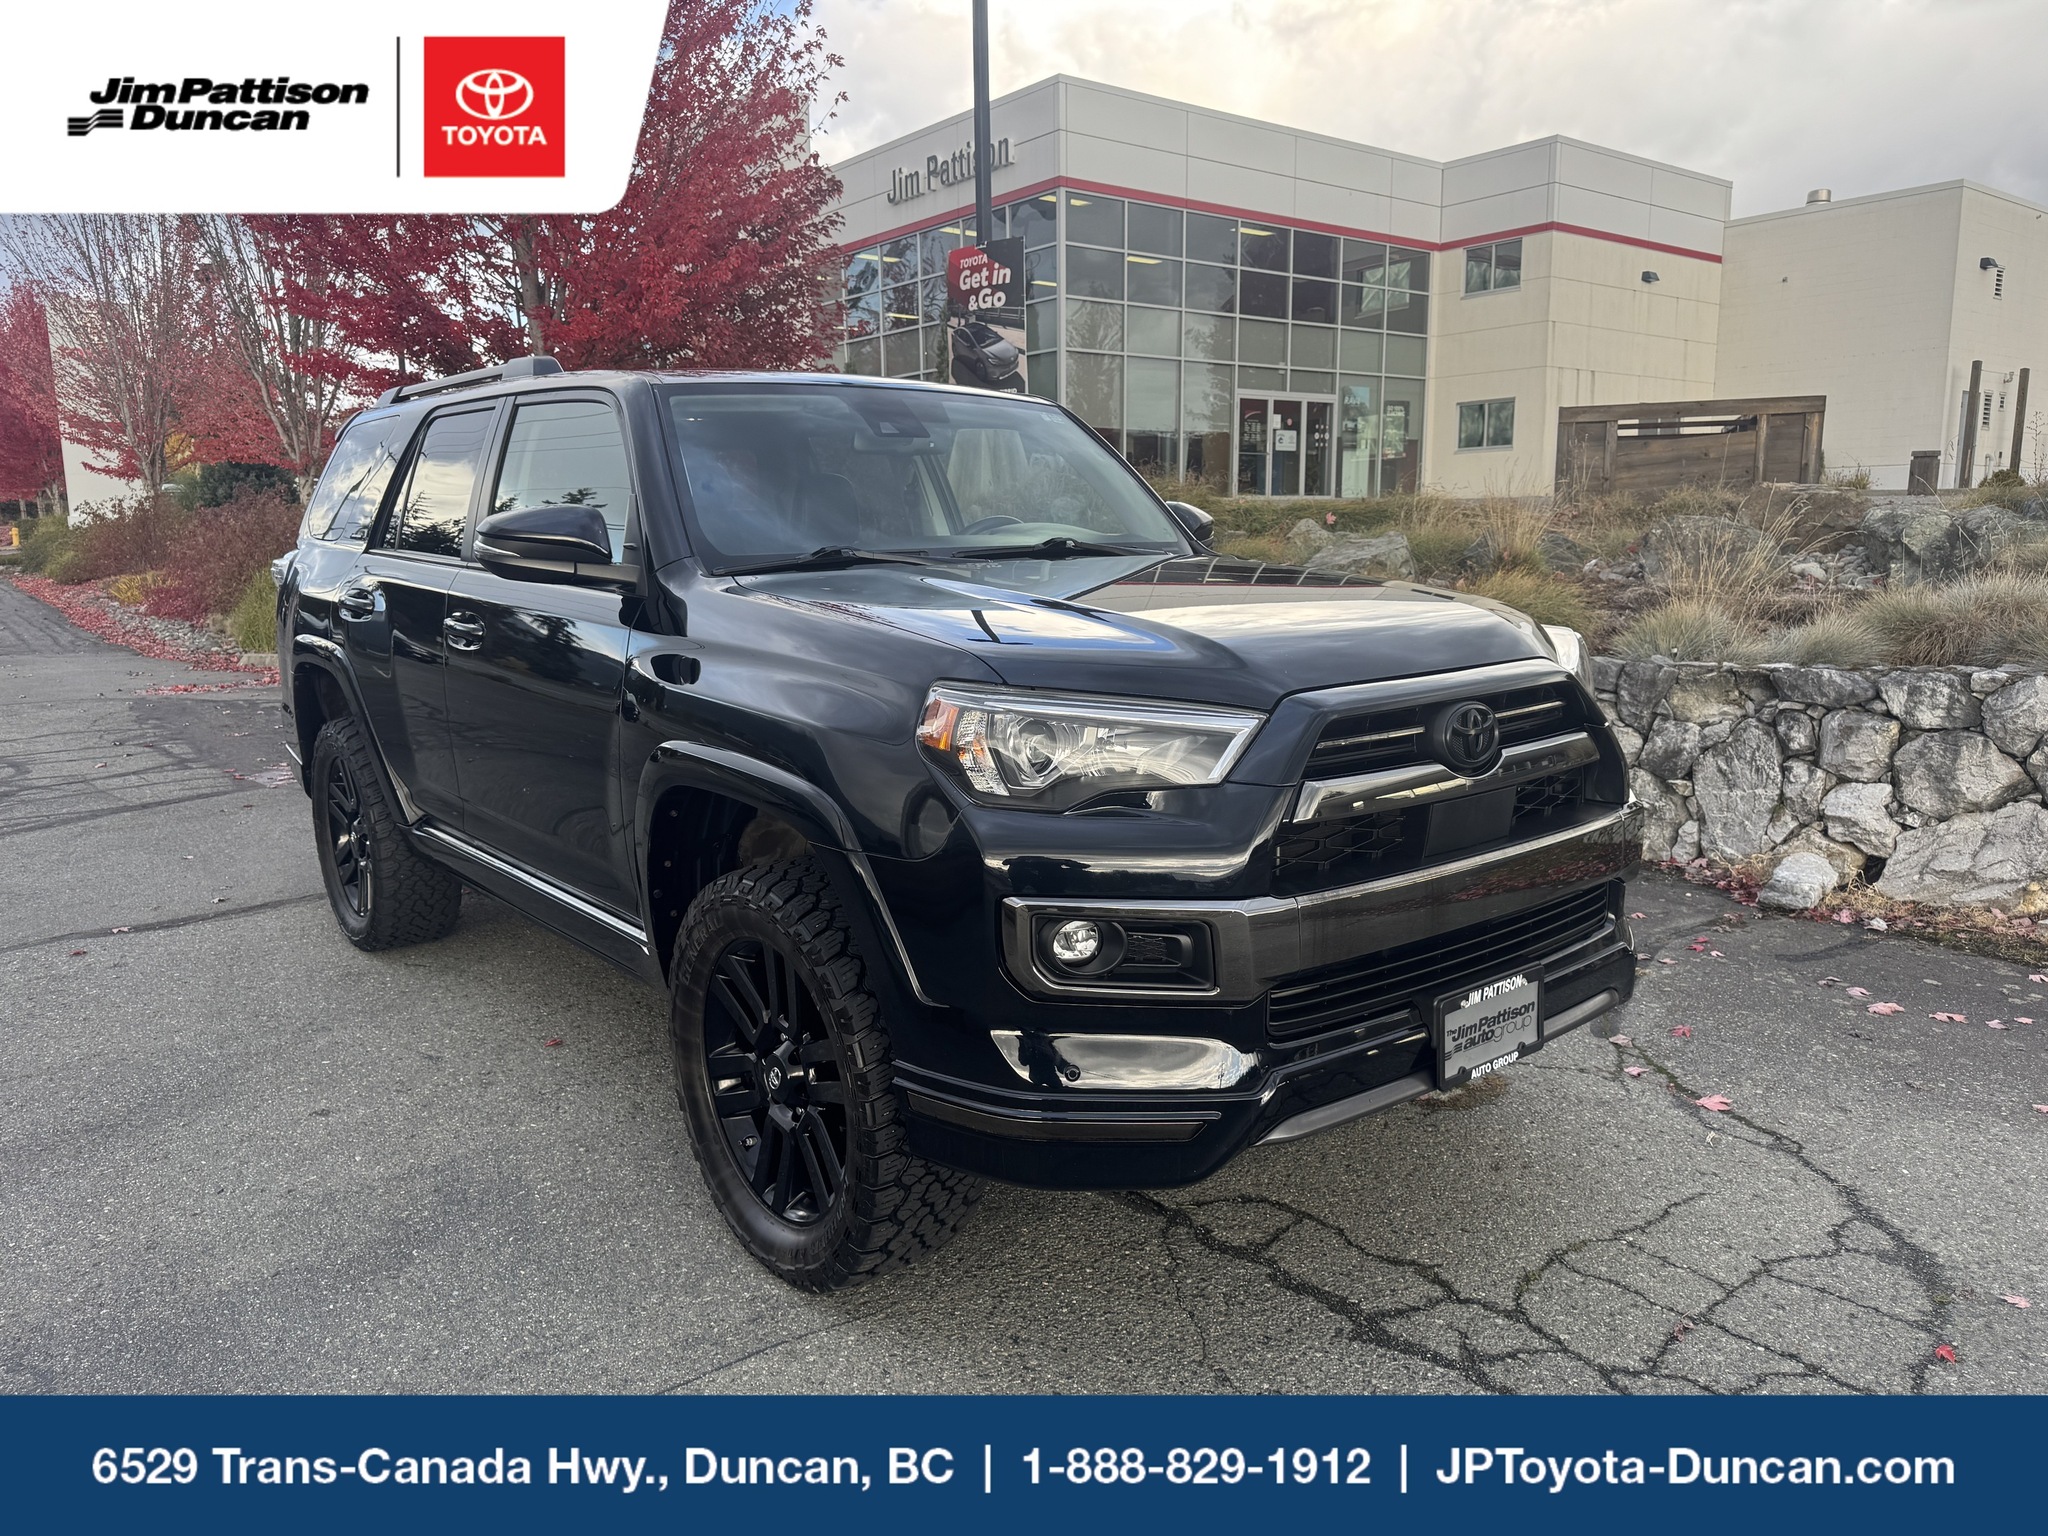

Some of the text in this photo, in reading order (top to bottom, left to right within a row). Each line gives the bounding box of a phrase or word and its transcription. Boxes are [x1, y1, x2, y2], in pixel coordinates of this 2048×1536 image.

[887, 138, 1010, 204] Jim Pattion
[960, 254, 988, 269] TOYOTA
[960, 262, 1011, 290] Get in
[968, 288, 1006, 311] &Go
[1466, 974, 1523, 1008] JIM PATTISON
[1478, 1001, 1535, 1032] Pattison
[1471, 1051, 1519, 1079] AUTO GROUP
